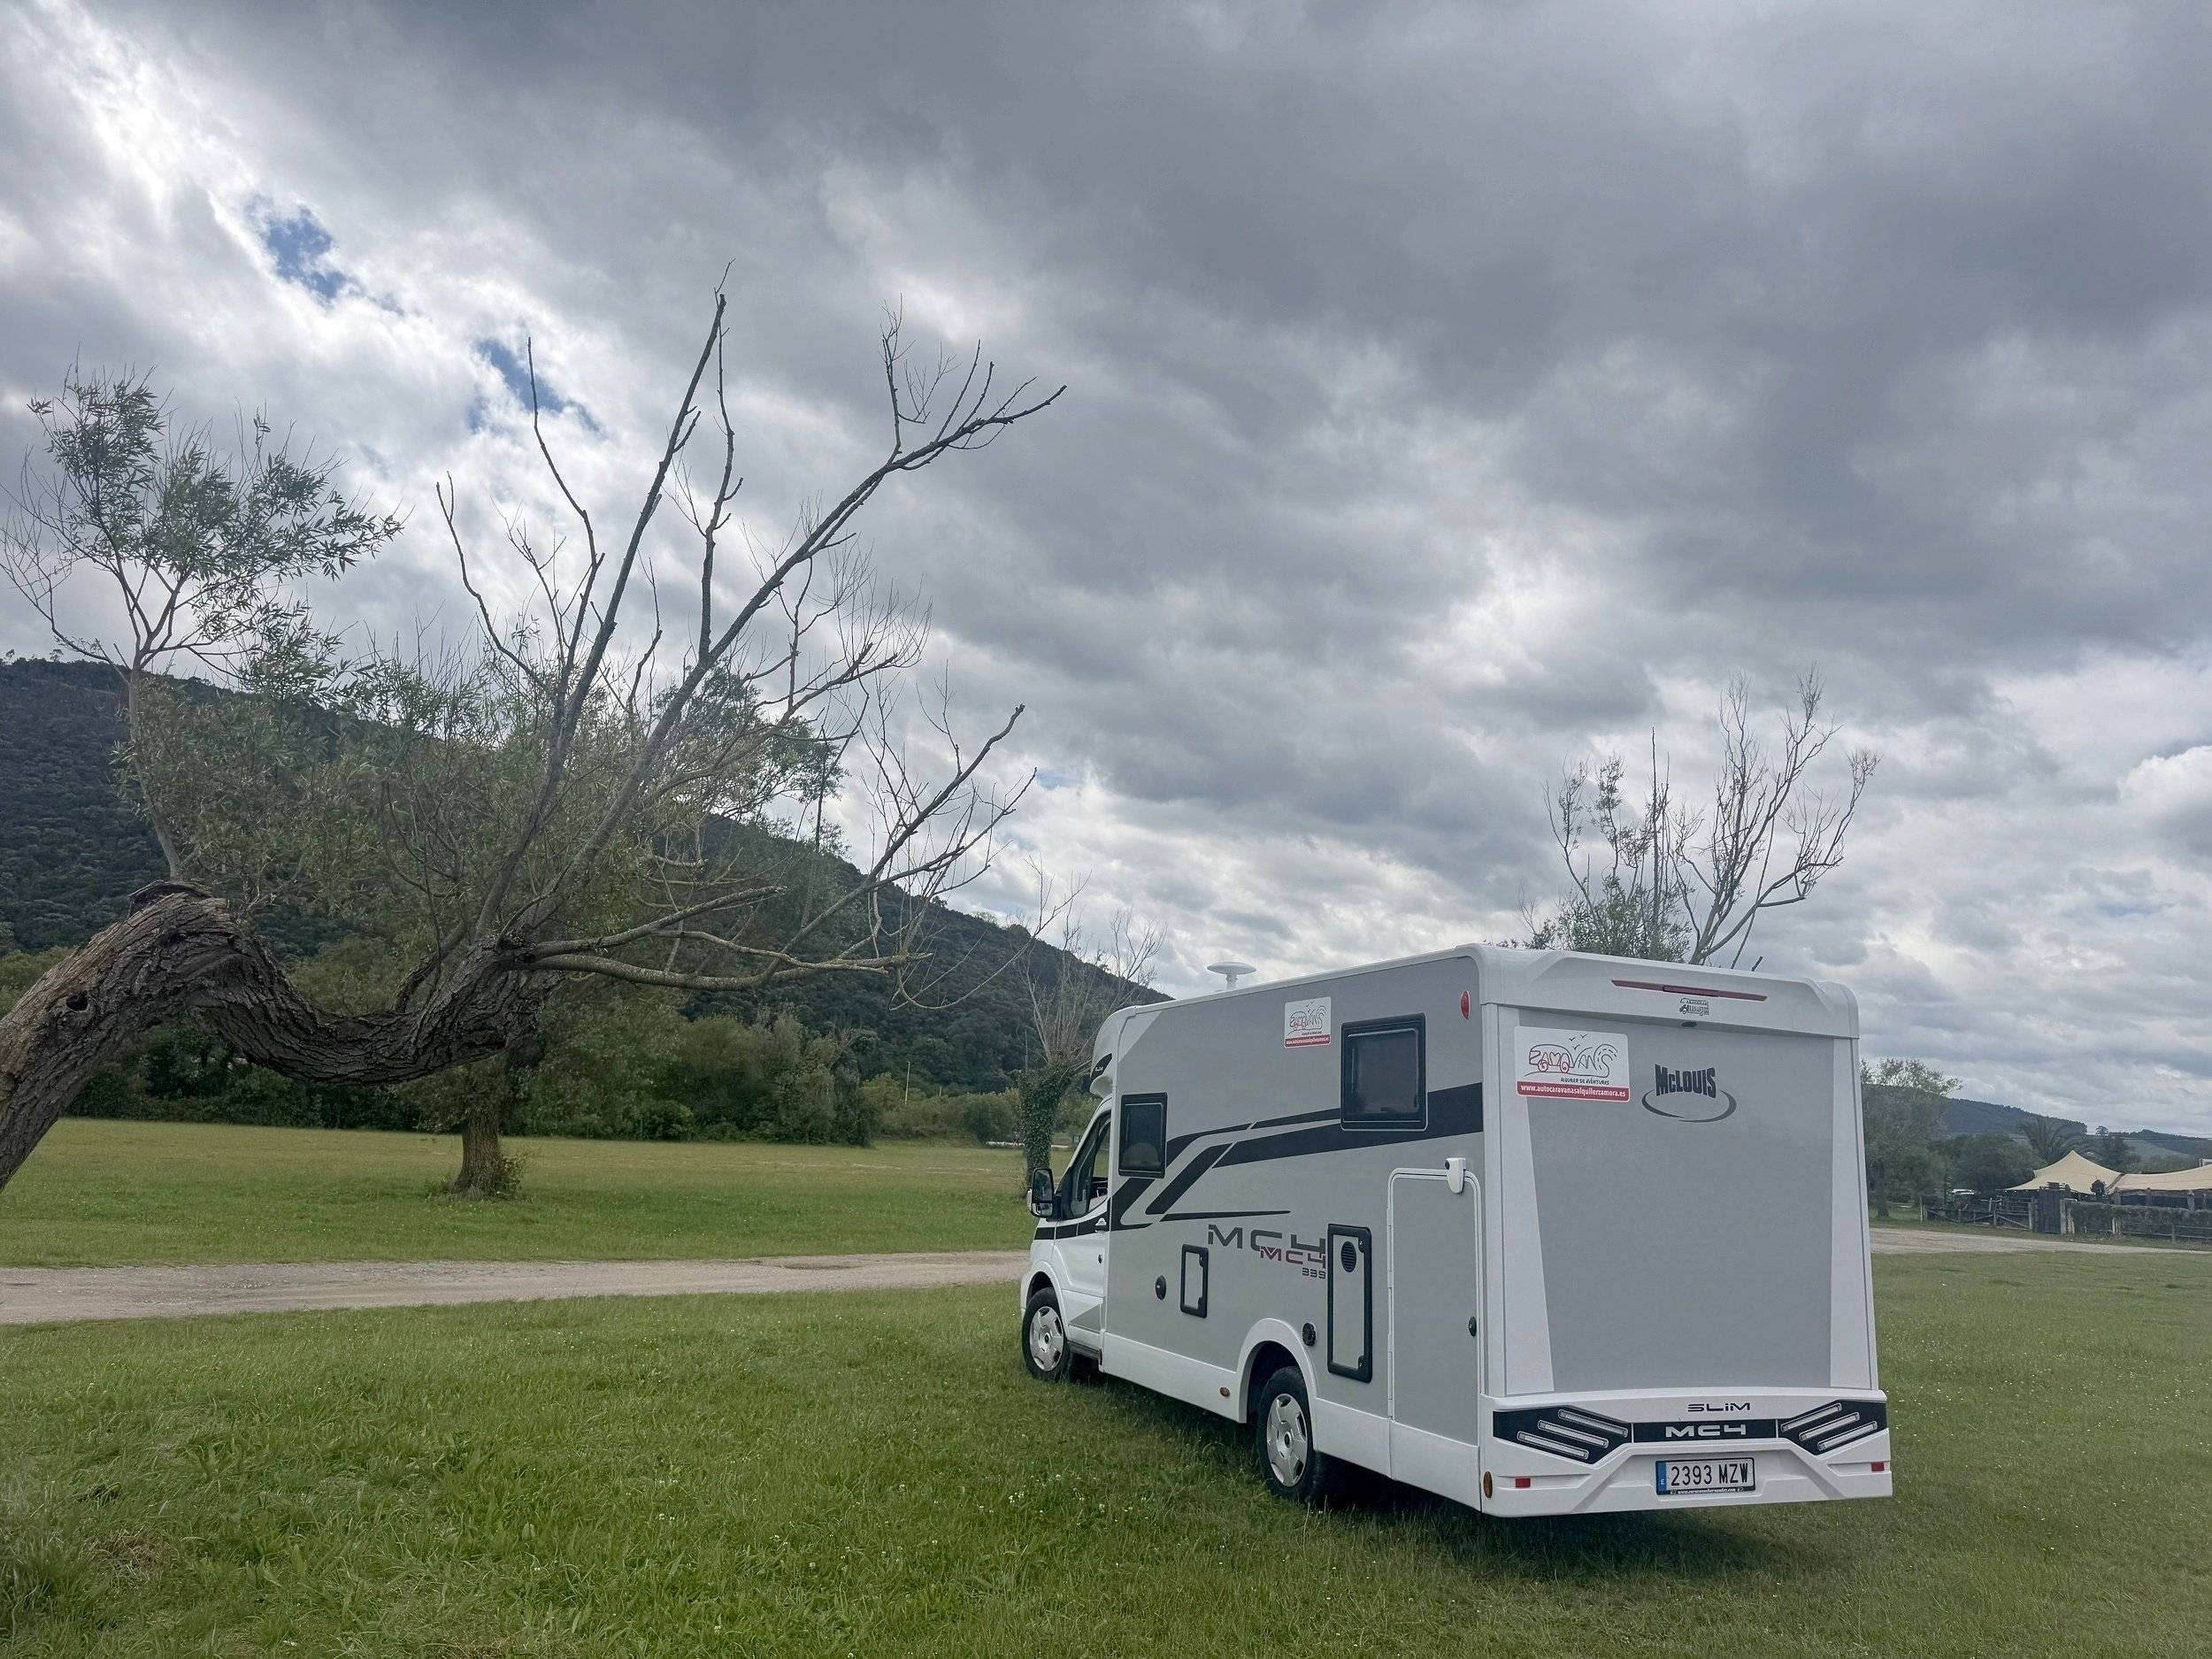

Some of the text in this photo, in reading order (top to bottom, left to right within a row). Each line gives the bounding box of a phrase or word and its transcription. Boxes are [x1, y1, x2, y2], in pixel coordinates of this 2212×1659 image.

[1208, 1224, 1326, 1260] MC4
[1260, 1246, 1326, 1269] MC4
[1302, 1267, 1326, 1279] 339
[1665, 1424, 1747, 1438] MC4
[1671, 1464, 1712, 1486] 2393
[1718, 1463, 1748, 1485] MZW
